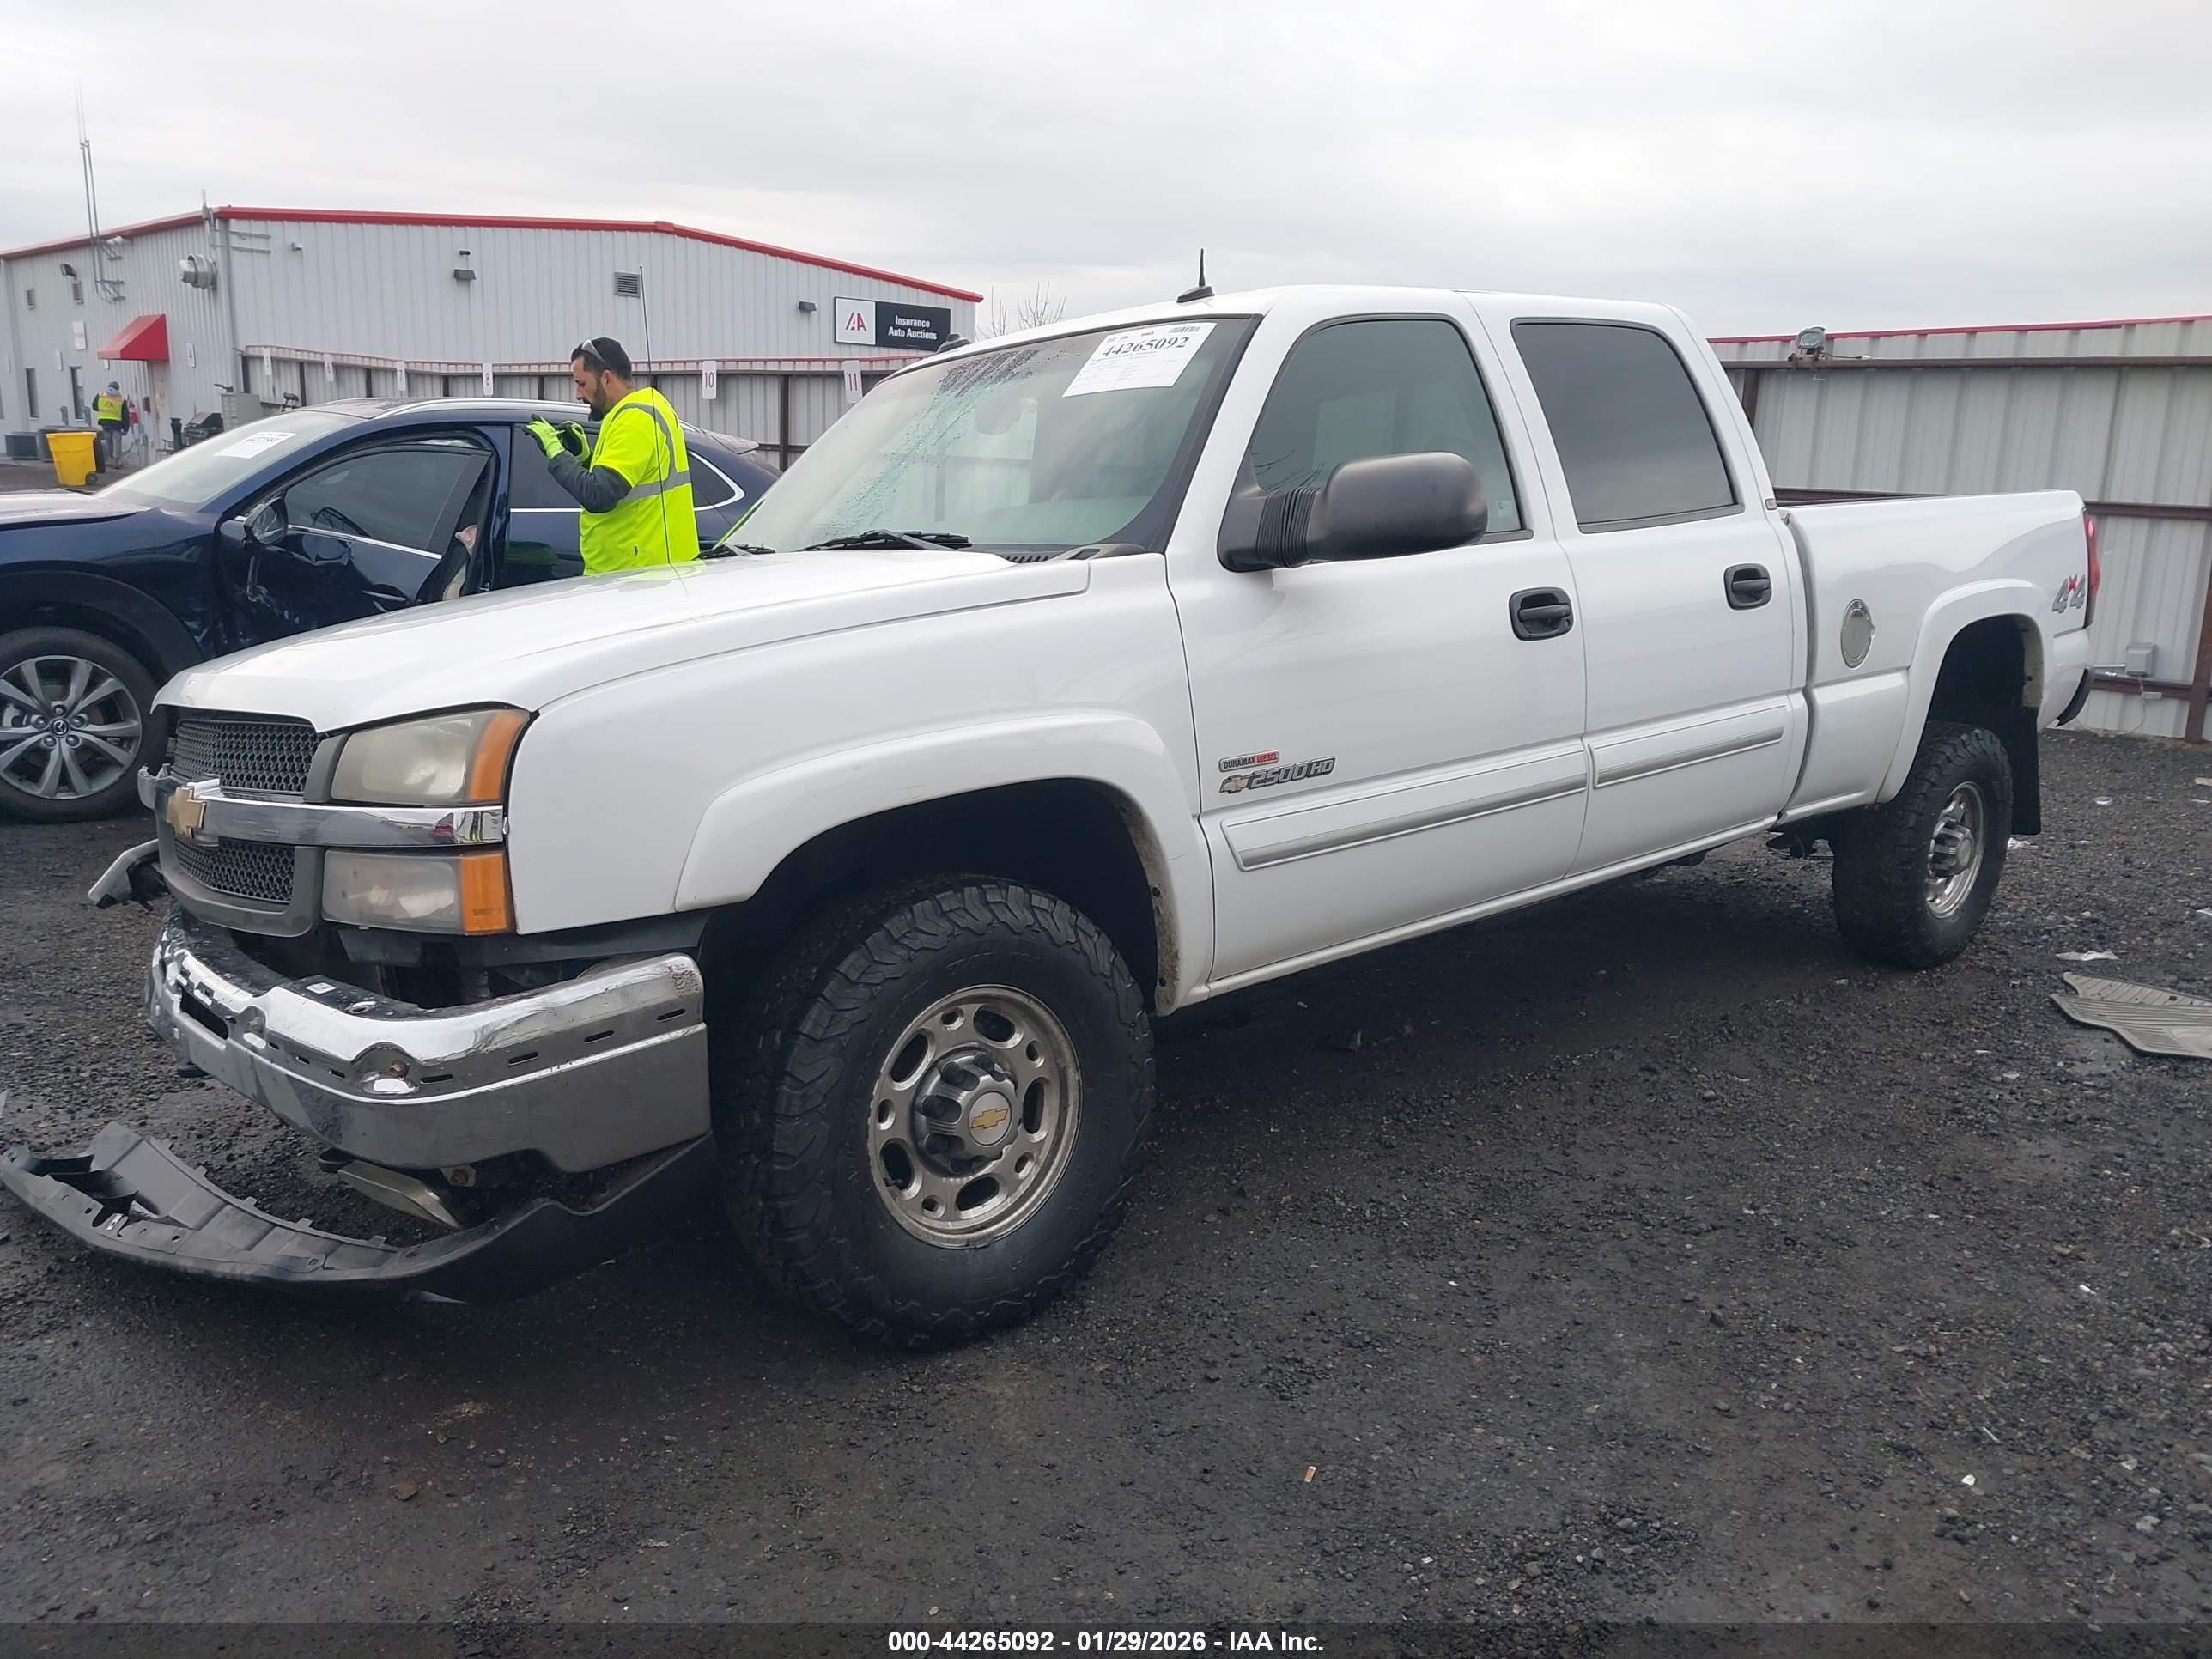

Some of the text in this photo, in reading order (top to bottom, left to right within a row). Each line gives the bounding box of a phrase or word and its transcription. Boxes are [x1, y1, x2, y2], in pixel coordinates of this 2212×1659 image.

[895, 315, 931, 328] Insurance
[888, 326, 938, 340] Auto Auctions
[1102, 336, 1190, 356] 44265092
[704, 371, 714, 388] 10
[848, 373, 858, 392] 11
[1224, 752, 1278, 769] DURAMAX DIESEL
